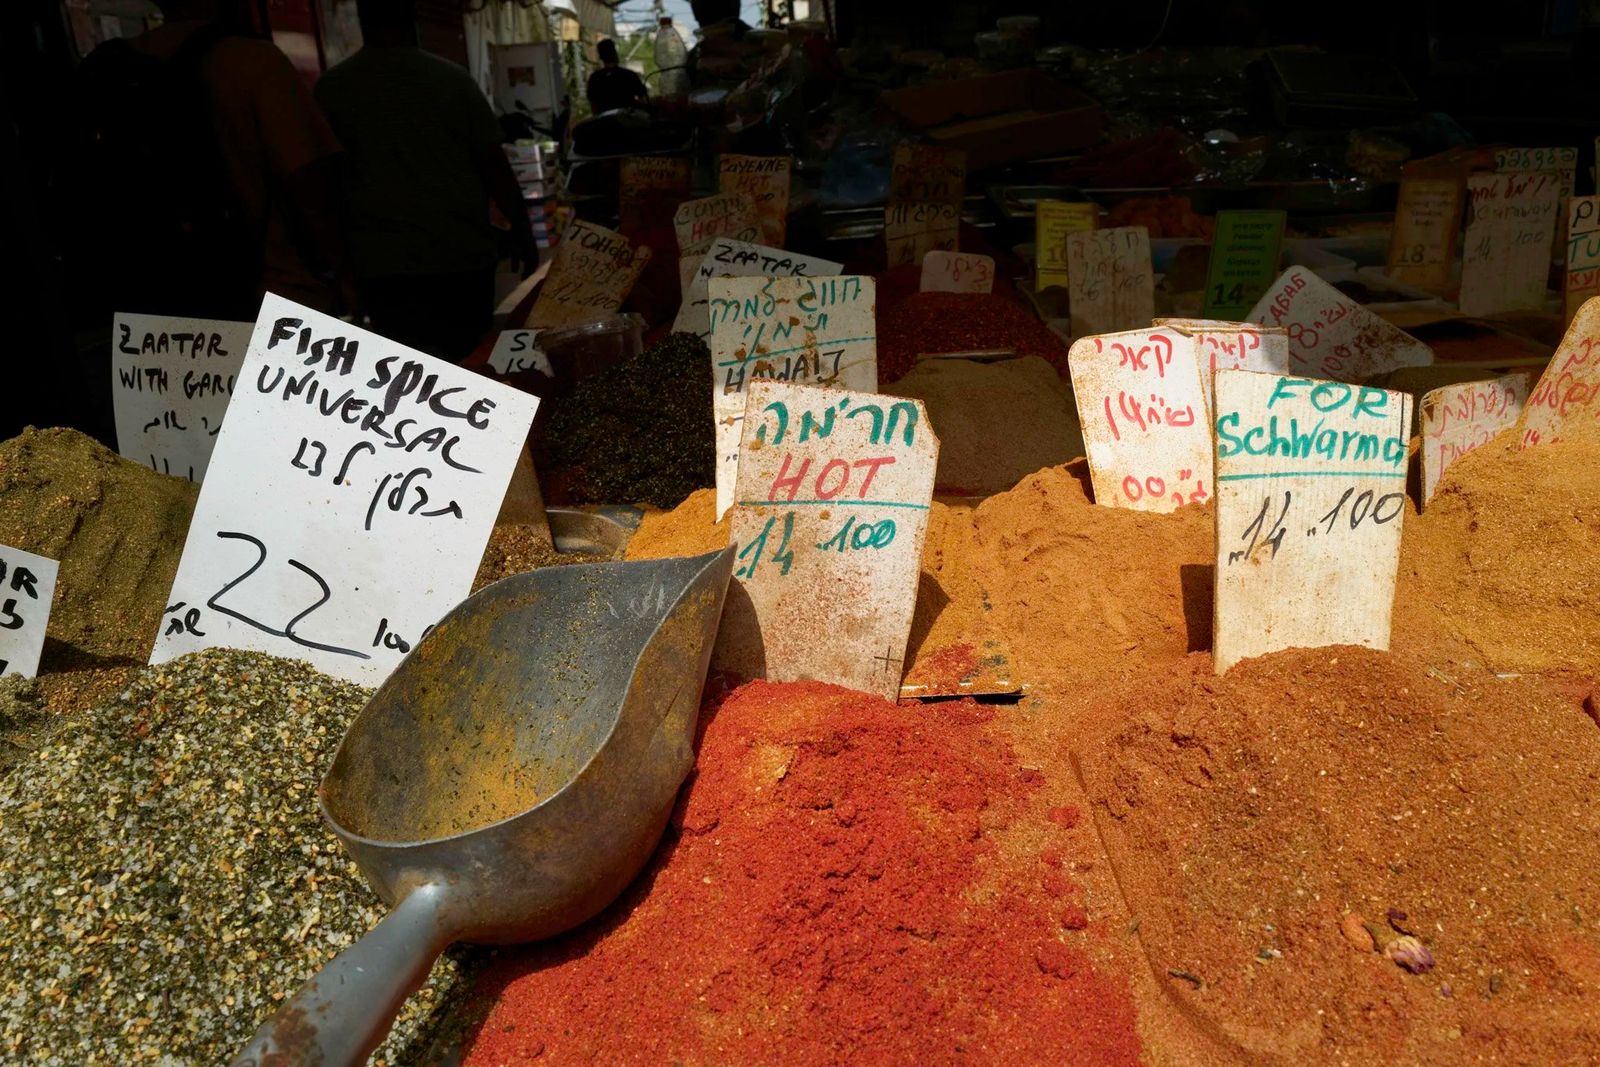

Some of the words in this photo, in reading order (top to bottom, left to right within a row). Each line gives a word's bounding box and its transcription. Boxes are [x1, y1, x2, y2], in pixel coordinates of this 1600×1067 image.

[690, 215, 732, 242] HOT
[714, 244, 809, 277] ZAATAR
[1213, 282, 1244, 306] 14
[119, 323, 229, 359] ZAATAR
[1094, 334, 1173, 378] קארי
[119, 365, 169, 395] WITH
[266, 317, 360, 377] FISH
[366, 356, 497, 431] SPICE
[256, 363, 484, 474] UNIVERSAL
[1266, 376, 1389, 420] FOR
[1216, 411, 1405, 469] Schwarma
[767, 452, 897, 502] HOT
[737, 510, 796, 579] 14
[823, 514, 897, 553] 100
[1240, 490, 1292, 562] 14
[1319, 486, 1405, 535] 100
[206, 530, 373, 660] 22
